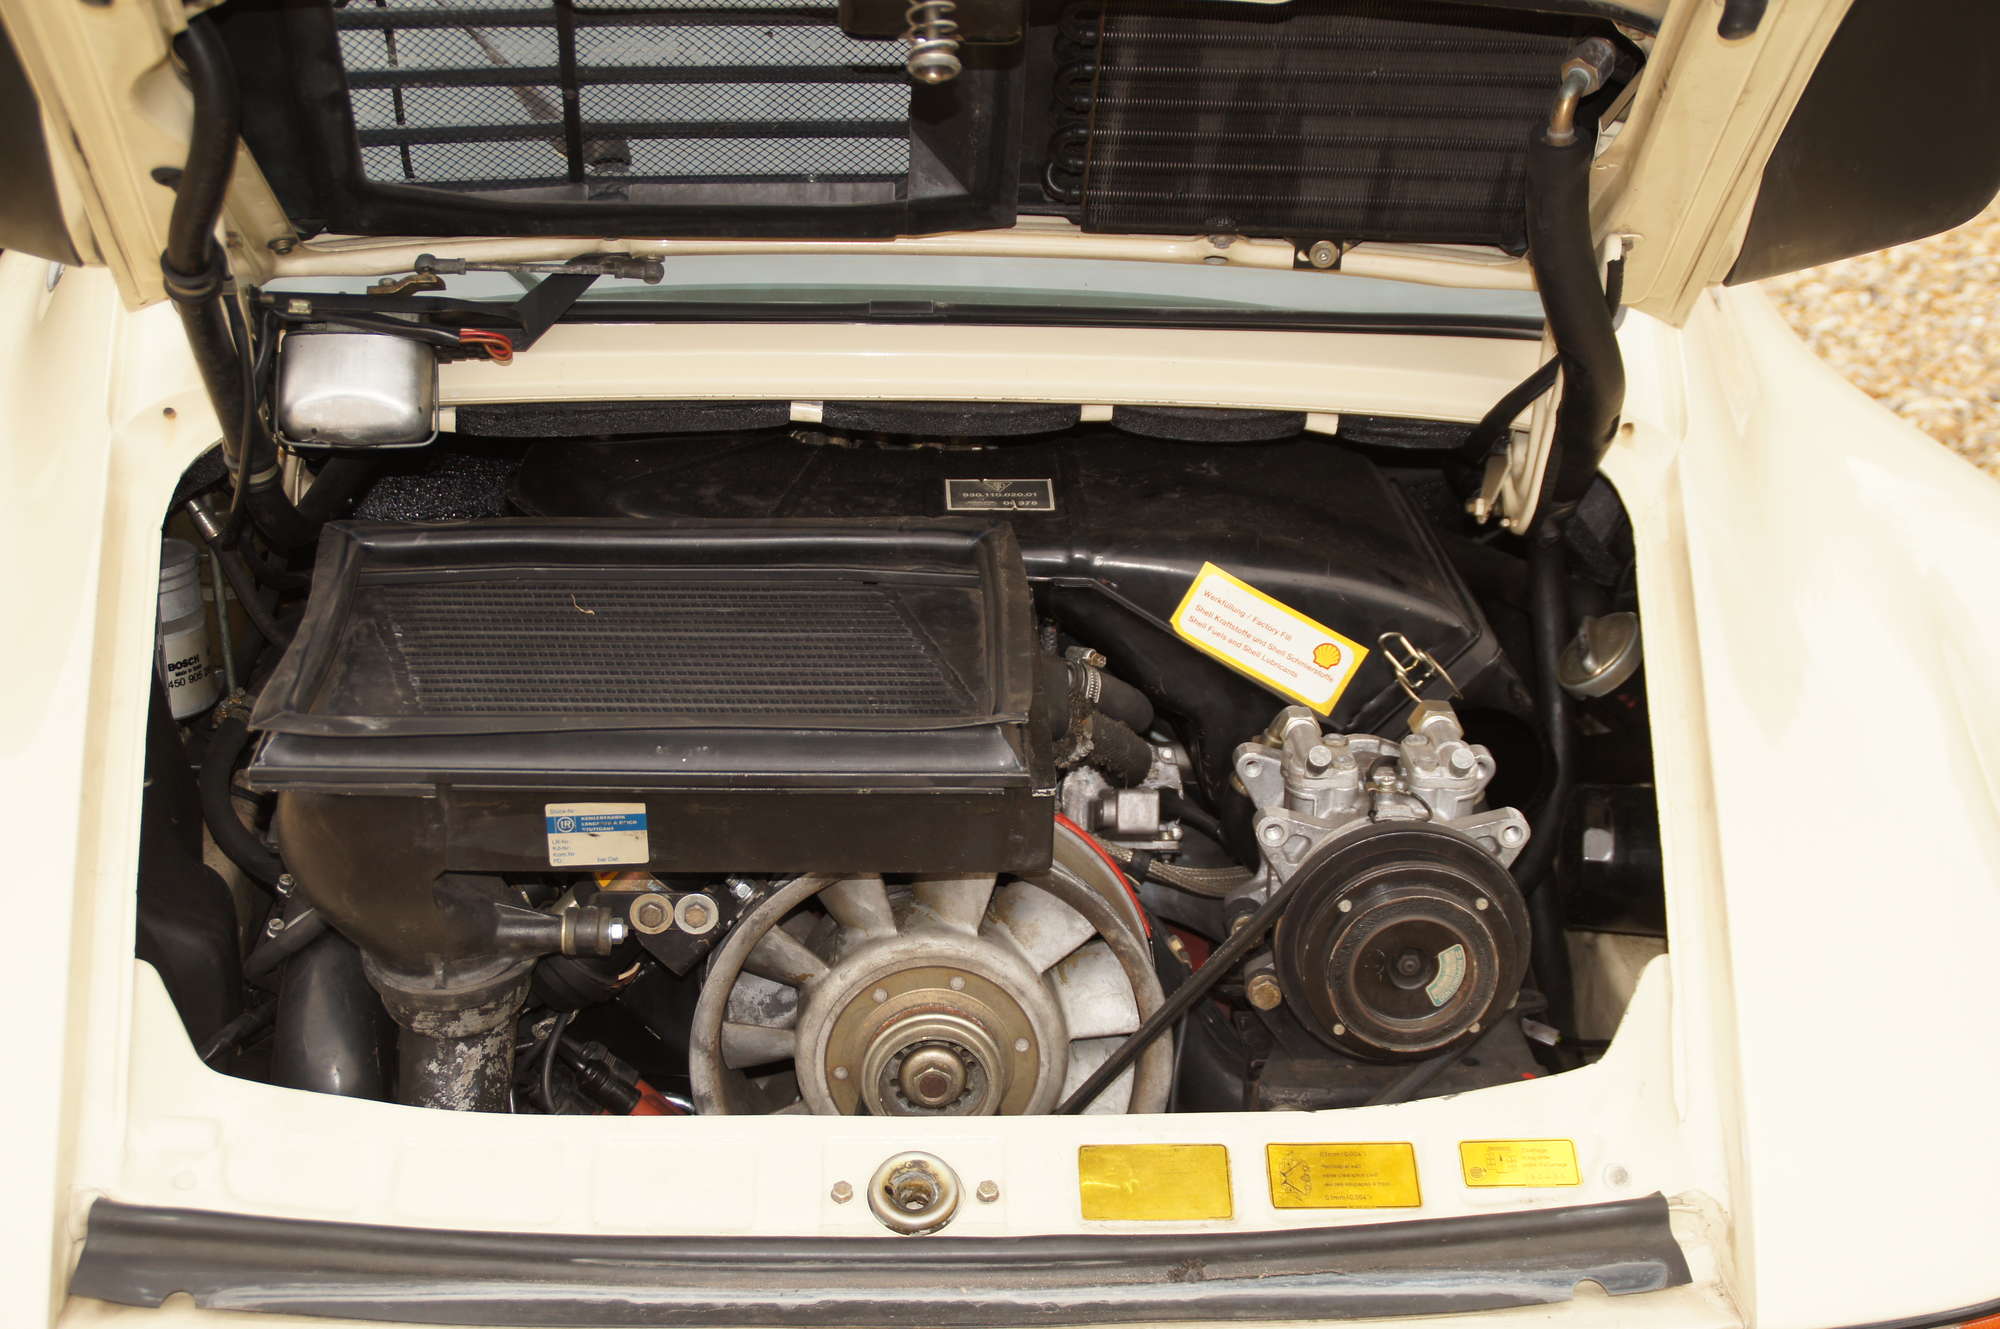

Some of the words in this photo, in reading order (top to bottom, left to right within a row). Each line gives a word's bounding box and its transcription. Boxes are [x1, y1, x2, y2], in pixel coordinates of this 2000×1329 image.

[1195, 604, 1214, 619] Shell
[1214, 615, 1251, 639] Kraftstoffe
[1252, 636, 1266, 647] und
[1268, 642, 1286, 657] Shell
[1288, 653, 1334, 682] Schmierstoffe
[1203, 590, 1247, 618] Werkfüllung
[1252, 616, 1279, 634] Factory
[1280, 632, 1293, 642] Fill
[168, 655, 200, 671] BOSCH
[1189, 615, 1208, 630] Shell
[1208, 625, 1226, 641] Fuels
[1228, 638, 1242, 649] and
[1244, 645, 1261, 658] Shell
[1262, 653, 1298, 679] Lubricants
